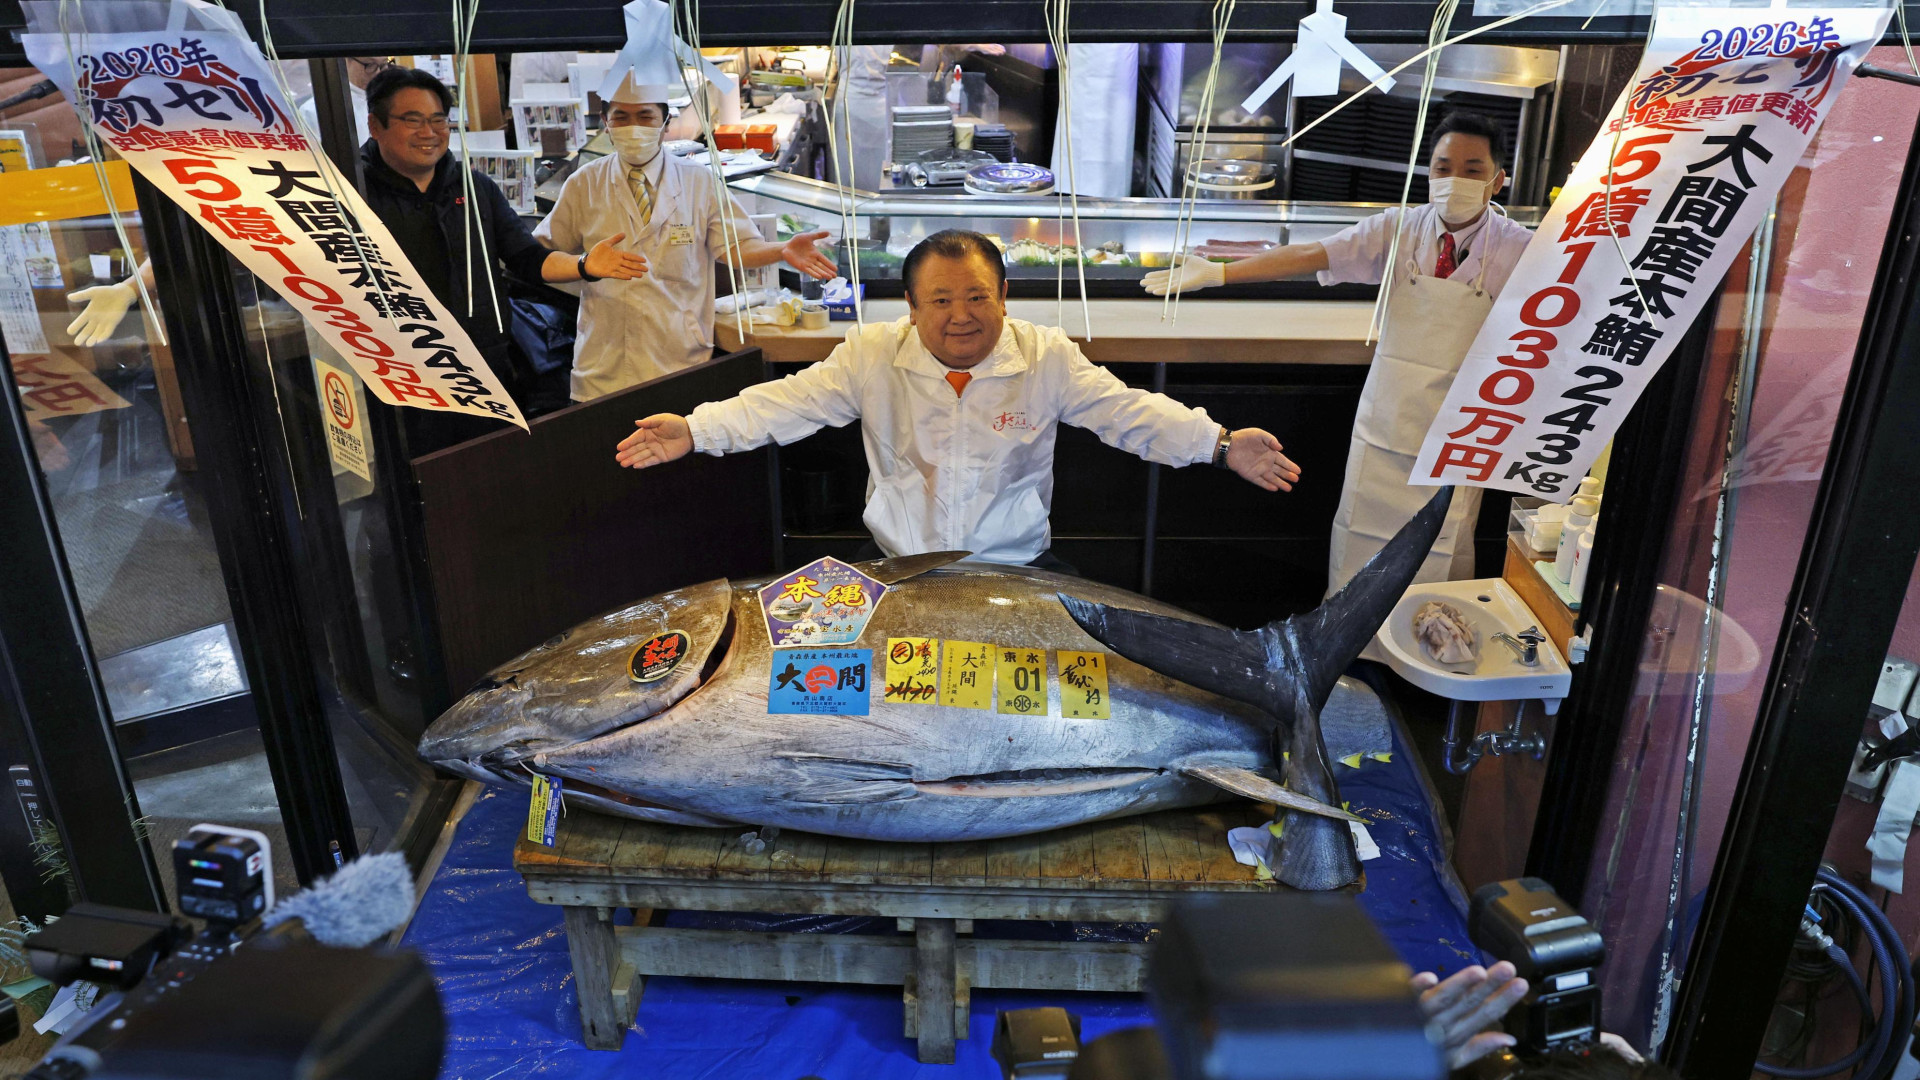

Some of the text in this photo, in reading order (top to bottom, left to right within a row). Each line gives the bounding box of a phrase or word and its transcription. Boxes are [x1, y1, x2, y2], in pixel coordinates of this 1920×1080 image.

[1699, 15, 1840, 61] 2026年
[77, 37, 219, 83] 2026年
[1631, 45, 1852, 107] 初セリ
[75, 77, 275, 132] 初セリ
[1604, 91, 1818, 136] 史上最高値更新
[109, 127, 310, 153] 史上最高値更新
[162, 158, 450, 408] 5億1030万円
[1429, 133, 1675, 482] 5億1030万円
[779, 576, 866, 607] 本縄
[774, 662, 866, 693] 大 間
[960, 652, 979, 688] 大間
[1013, 667, 1041, 692] 01
[1077, 656, 1098, 668] 01
[16, 779, 33, 787] 自動
